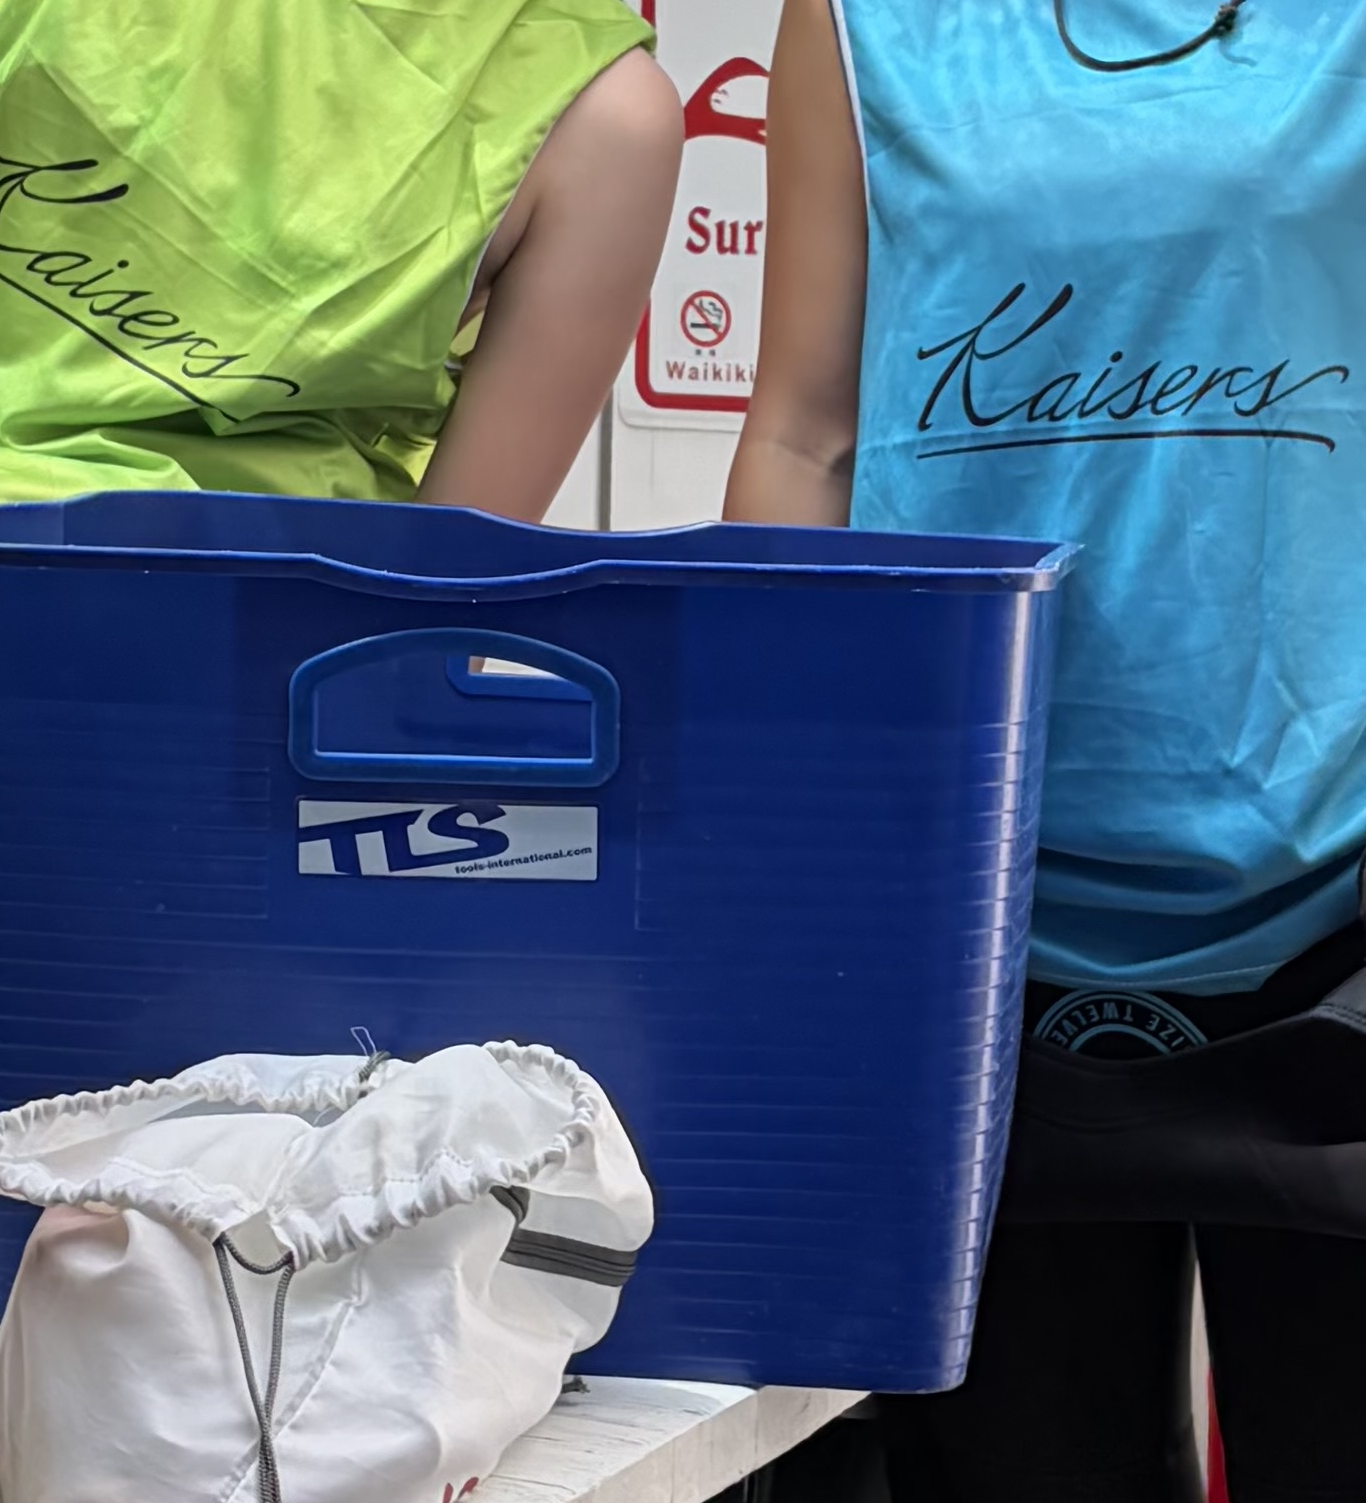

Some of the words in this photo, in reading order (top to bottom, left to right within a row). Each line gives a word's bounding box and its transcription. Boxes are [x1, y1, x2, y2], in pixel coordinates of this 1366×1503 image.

[665, 360, 754, 384] Waikiki
[916, 282, 1350, 432] Kaisers
[299, 803, 510, 875] TLS
[454, 846, 594, 875] tools-international.com
[1050, 1000, 1134, 1046] TWELVE
[1145, 1013, 1186, 1047] IZE
